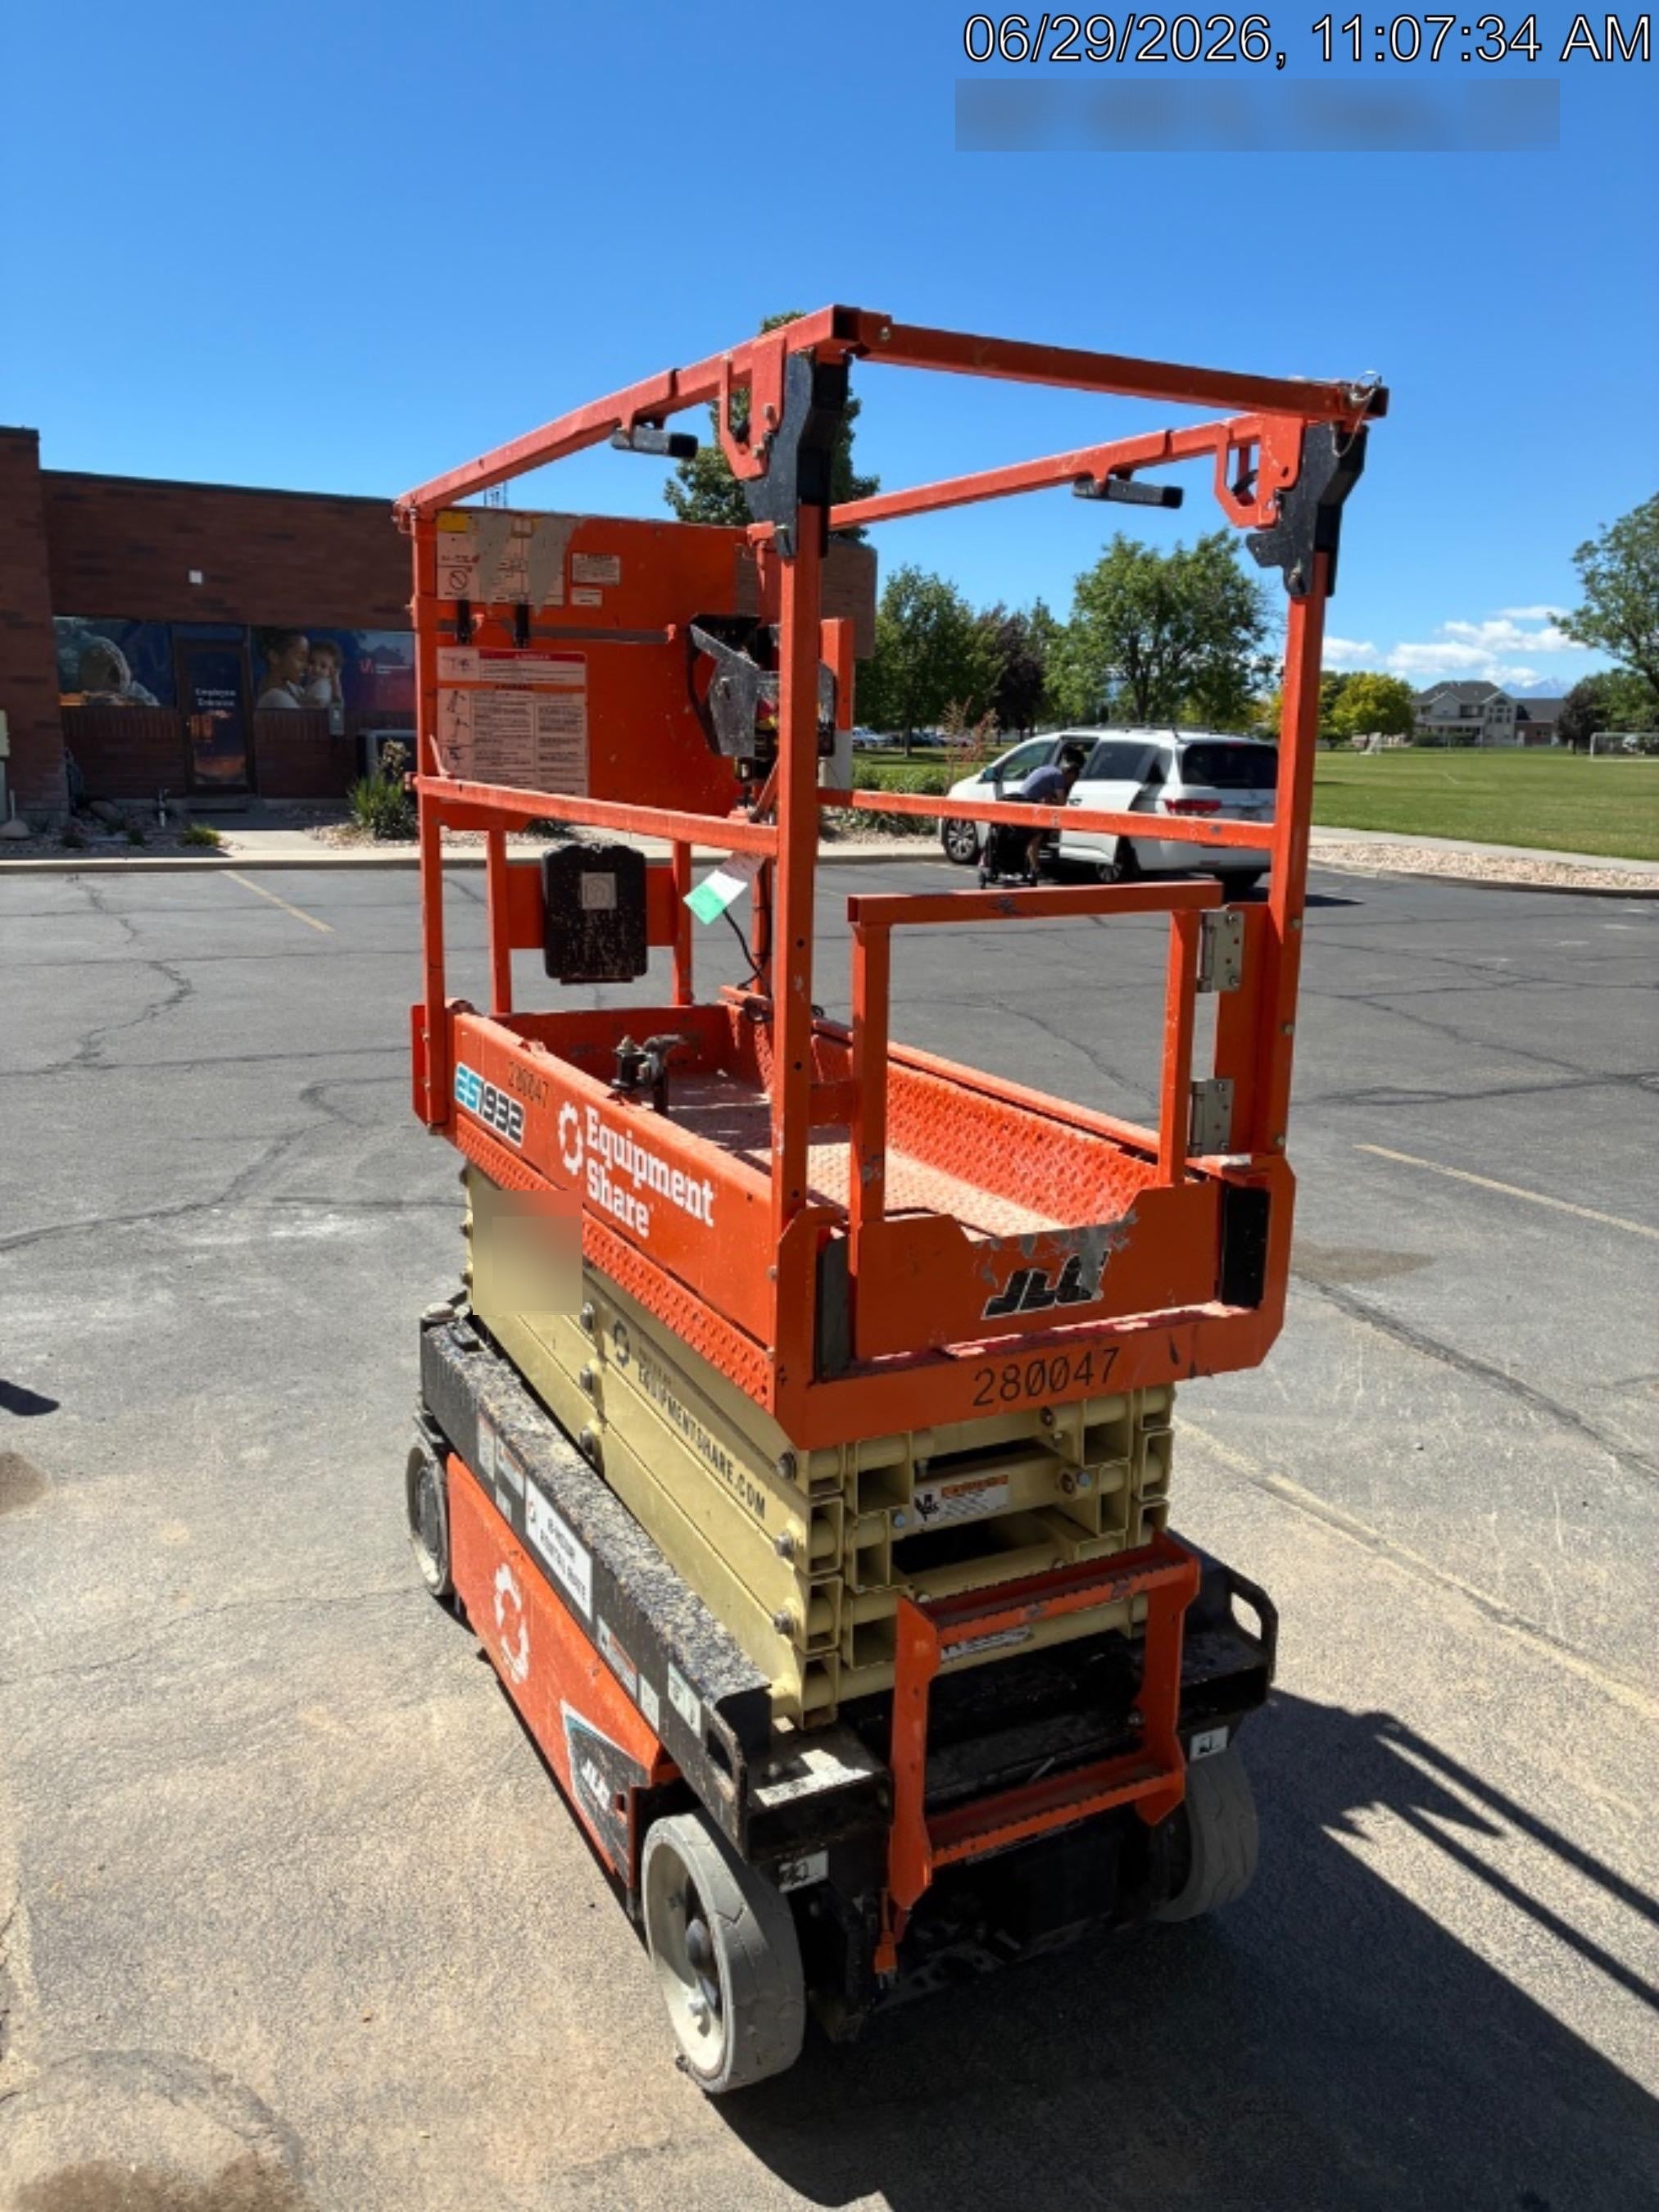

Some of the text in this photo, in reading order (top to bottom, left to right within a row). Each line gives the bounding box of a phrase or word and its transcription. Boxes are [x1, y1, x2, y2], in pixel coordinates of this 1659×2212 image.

[586, 1105, 714, 1227] Equipment
[587, 1157, 650, 1240] Share
[972, 1346, 1119, 1407] 280047
